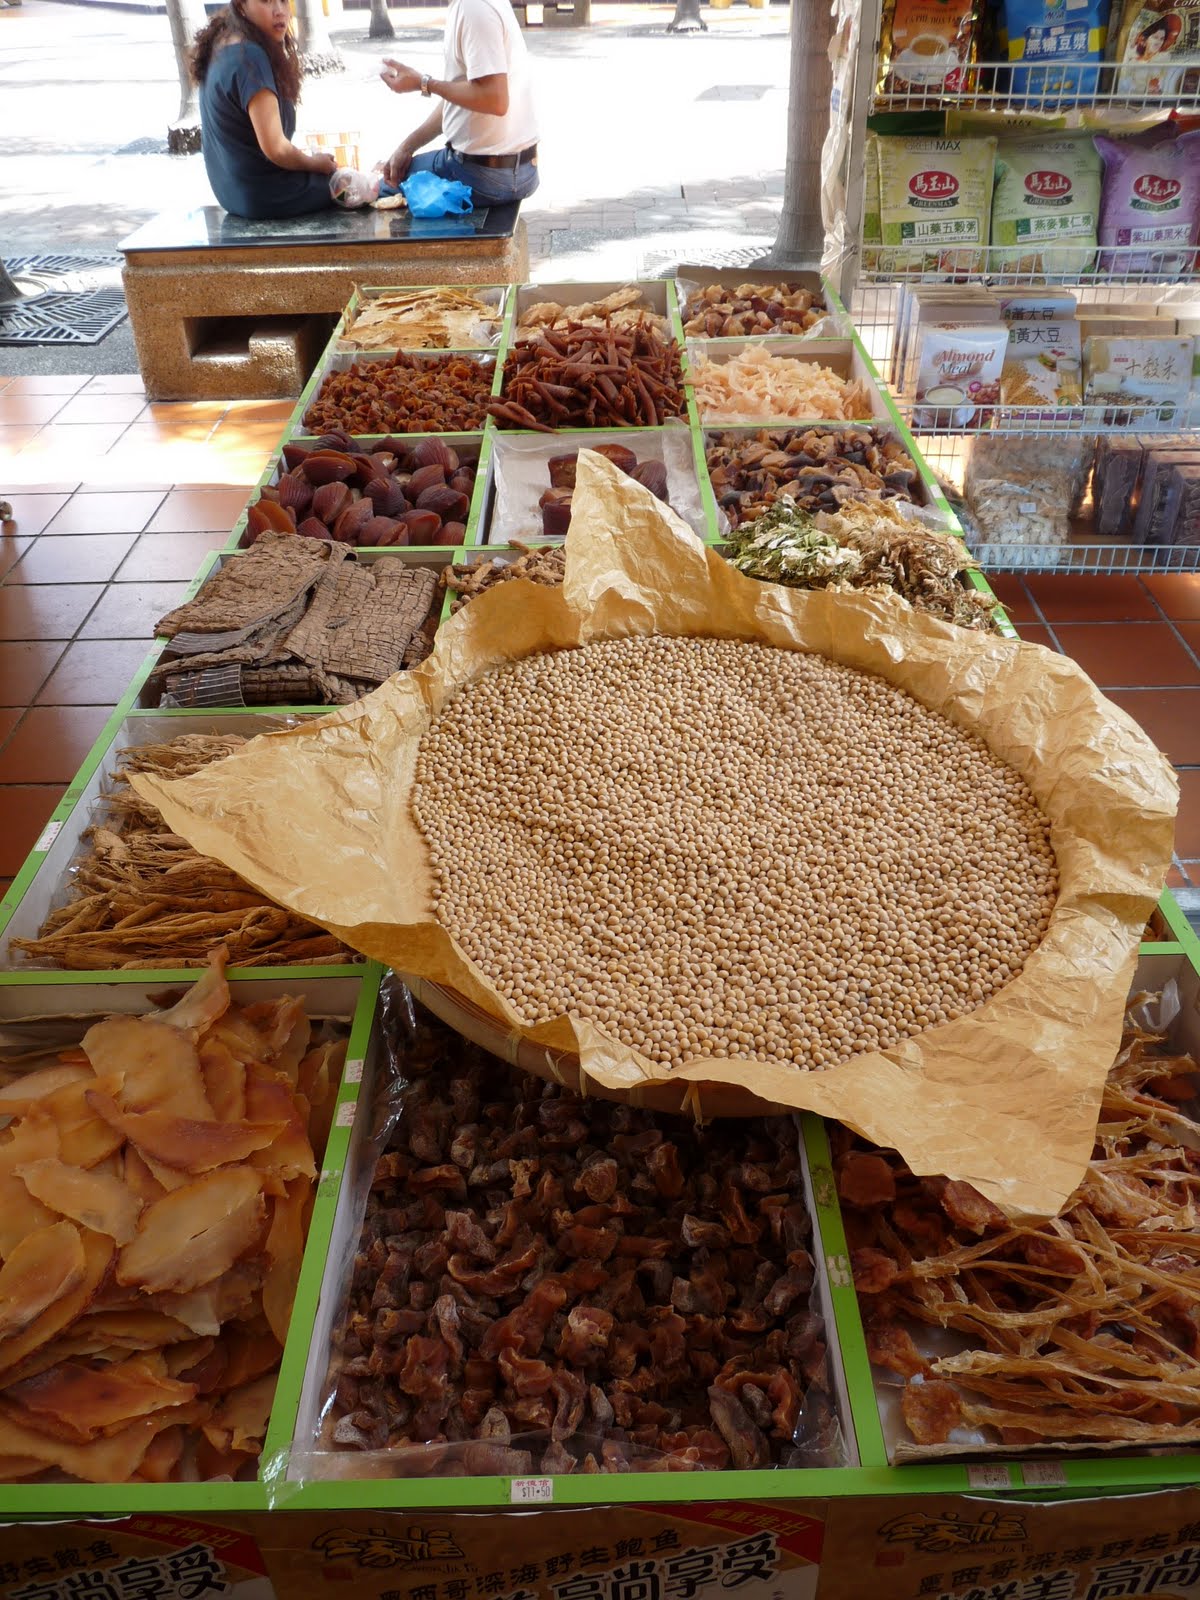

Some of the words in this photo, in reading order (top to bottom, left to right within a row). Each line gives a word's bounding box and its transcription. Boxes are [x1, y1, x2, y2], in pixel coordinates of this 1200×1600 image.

[1026, 32, 1087, 55] 無糖豆漿
[915, 175, 956, 193] 馬玉山
[1030, 173, 1069, 191] 馬玉山
[1139, 177, 1178, 196] 馬玉山
[913, 199, 955, 208] GREENMAX
[918, 220, 976, 236] 山藥五穀粥
[1016, 327, 1061, 344] 黃大豆
[937, 348, 995, 362] Almond
[938, 362, 973, 374] Meal
